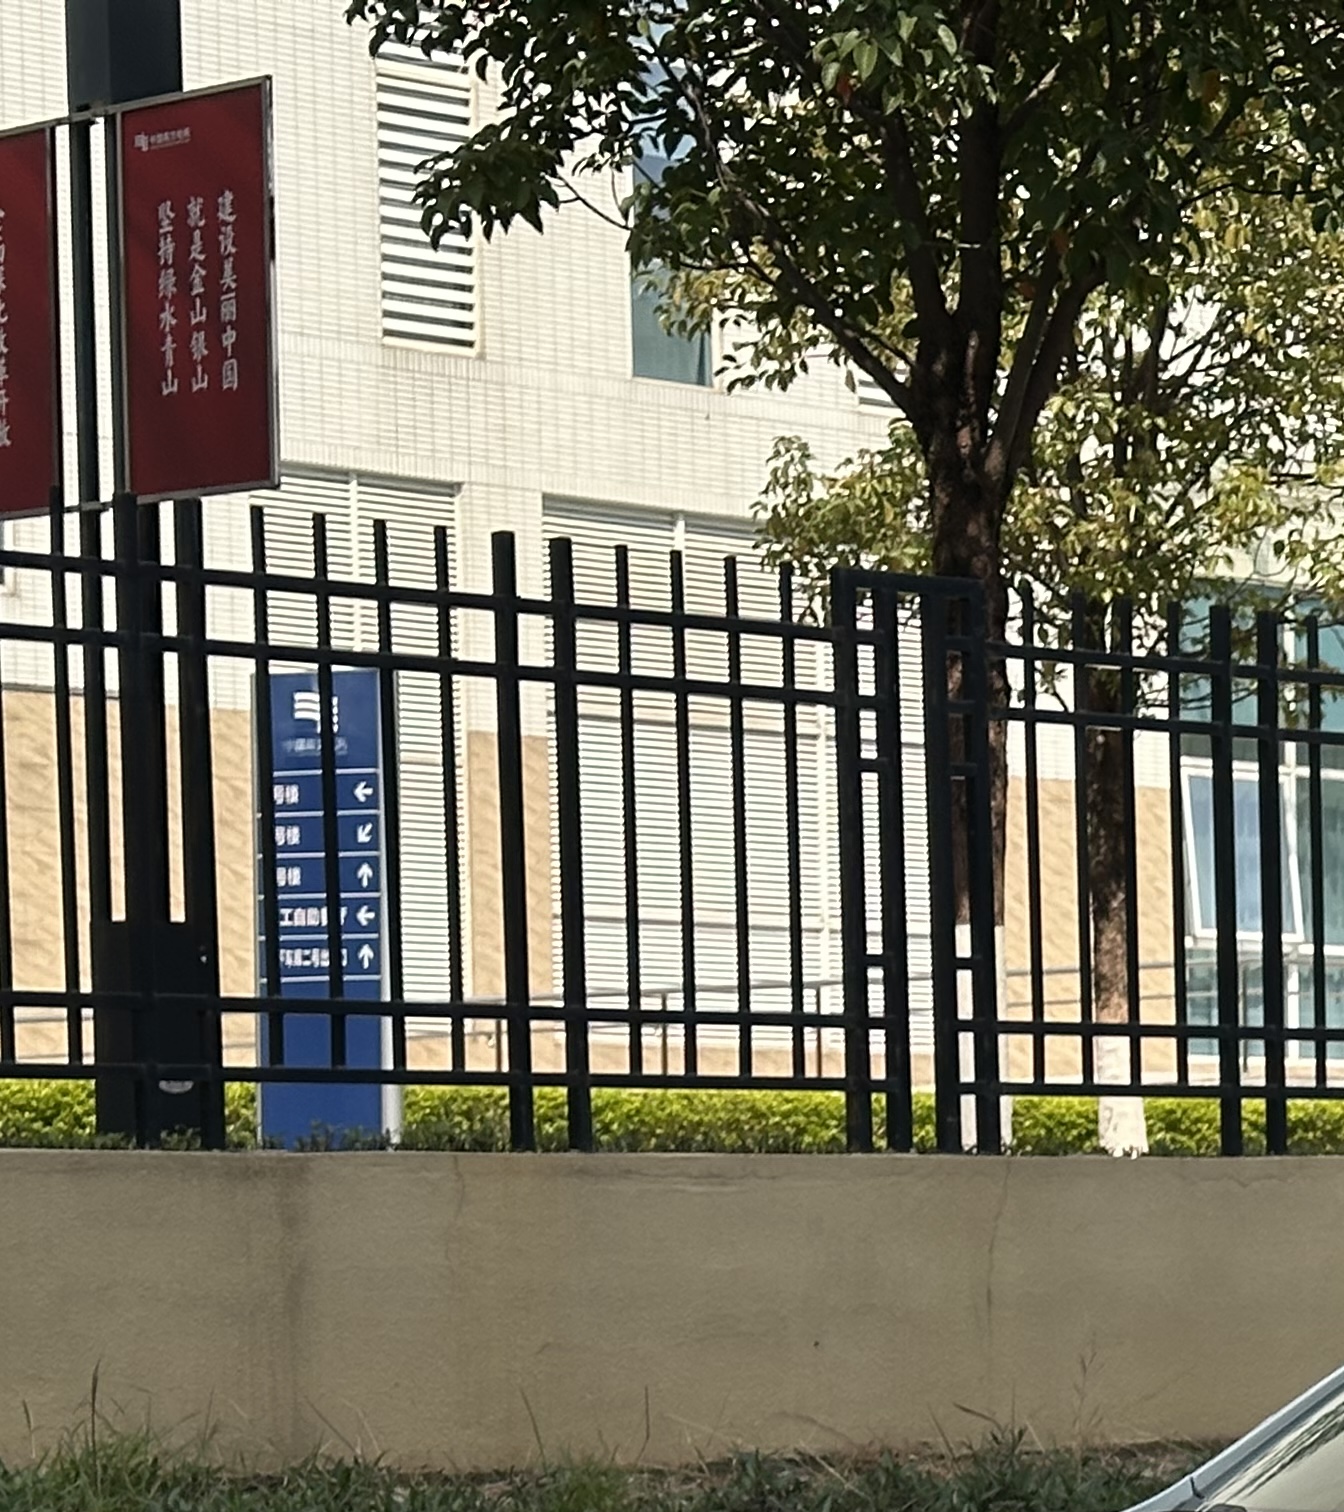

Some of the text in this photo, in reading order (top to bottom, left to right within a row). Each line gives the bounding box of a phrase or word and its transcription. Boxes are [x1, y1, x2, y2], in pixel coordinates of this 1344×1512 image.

[158, 200, 178, 395] 坚持绿水青山
[187, 196, 208, 392] 就是金山银山
[218, 190, 238, 391] 建设美丽中国
